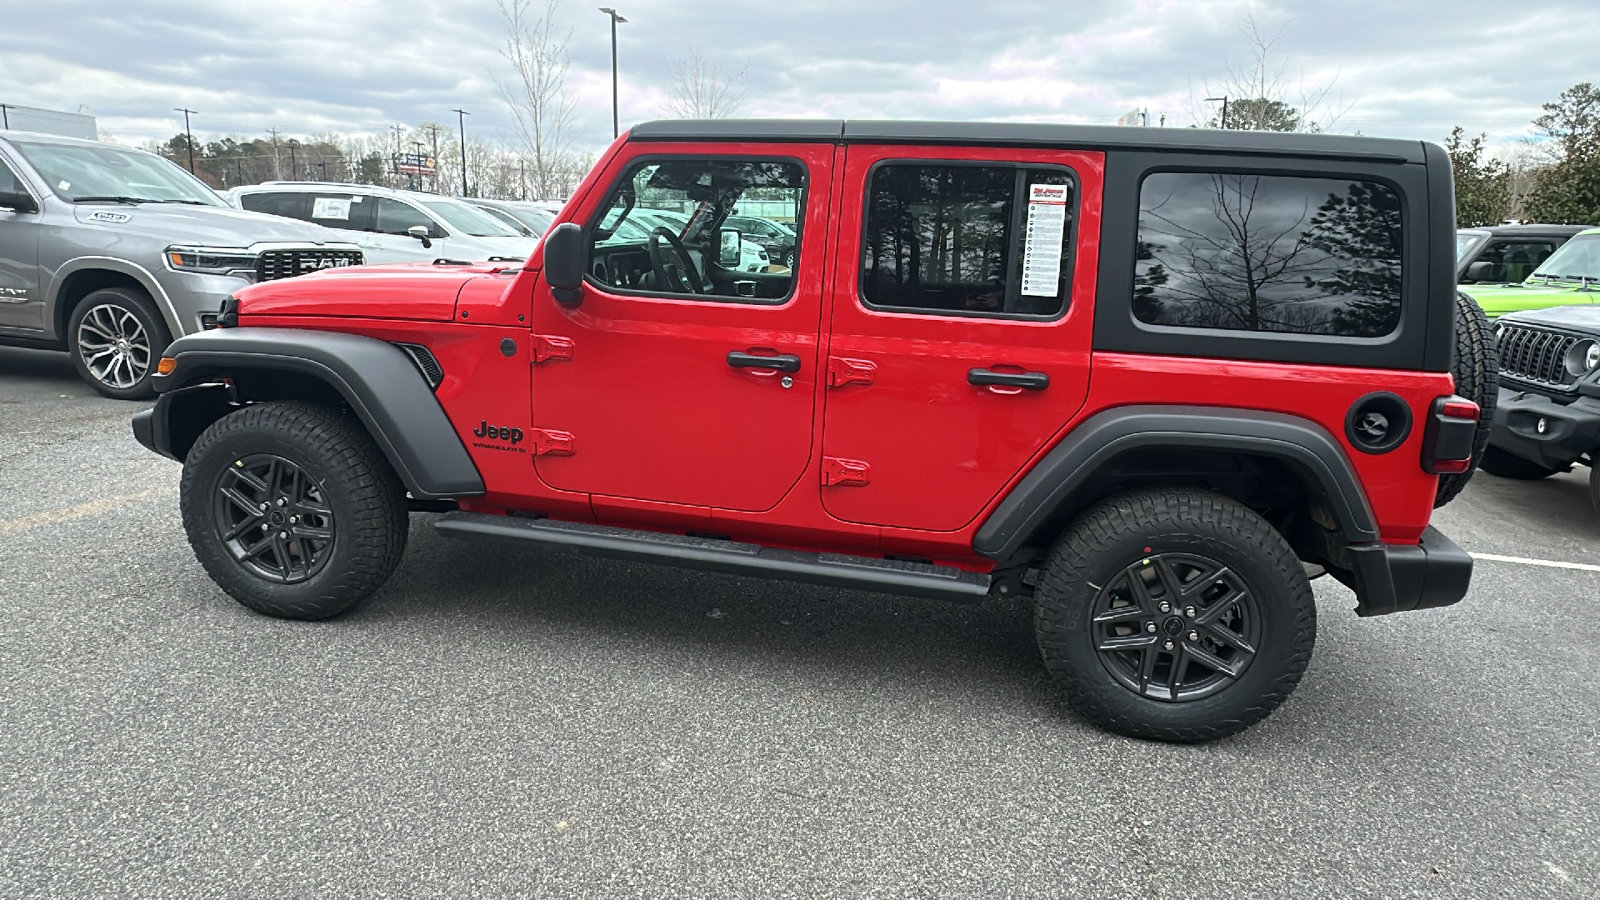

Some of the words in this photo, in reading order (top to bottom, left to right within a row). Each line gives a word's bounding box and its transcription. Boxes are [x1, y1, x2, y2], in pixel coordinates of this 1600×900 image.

[299, 258, 349, 269] RAM
[473, 420, 524, 445] Jeep
[473, 443, 517, 452] WRANGLER
